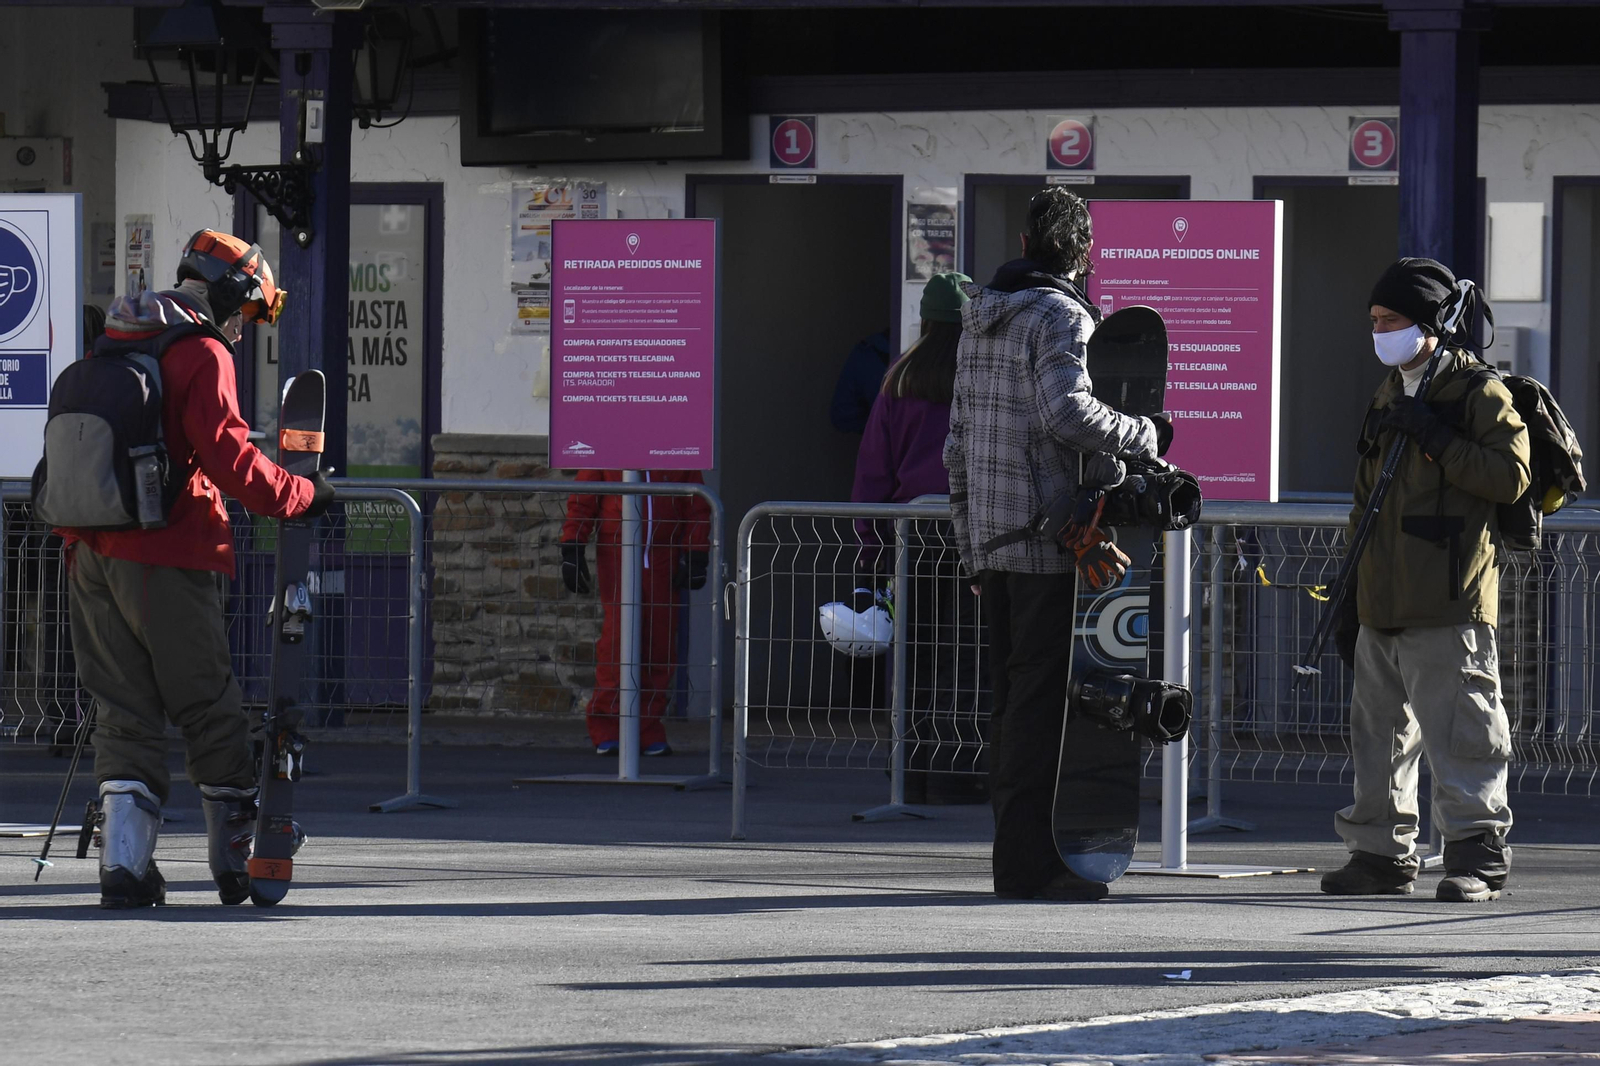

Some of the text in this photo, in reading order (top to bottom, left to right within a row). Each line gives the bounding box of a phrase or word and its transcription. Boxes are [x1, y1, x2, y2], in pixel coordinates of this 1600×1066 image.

[785, 129, 800, 154] 1
[1061, 130, 1080, 155] 2
[1363, 130, 1383, 156] 3
[927, 230, 953, 238] TARJETA
[1101, 248, 1260, 260] RETIRADA PEDIDOS ONLINE
[564, 259, 702, 269] RETIRADA PEDIDOS ONLINE
[633, 339, 687, 347] ESQUIADORES
[1180, 343, 1241, 353] ESQUIADORES
[362, 331, 408, 366] MÁS
[1174, 362, 1228, 371] TELECABINA
[563, 378, 615, 387] (TS. PARADOR)
[1173, 382, 1219, 390] TELESILLA
[1220, 382, 1257, 391] URBANO
[1173, 410, 1218, 419] TELESILLA
[1219, 411, 1243, 419] JARA
